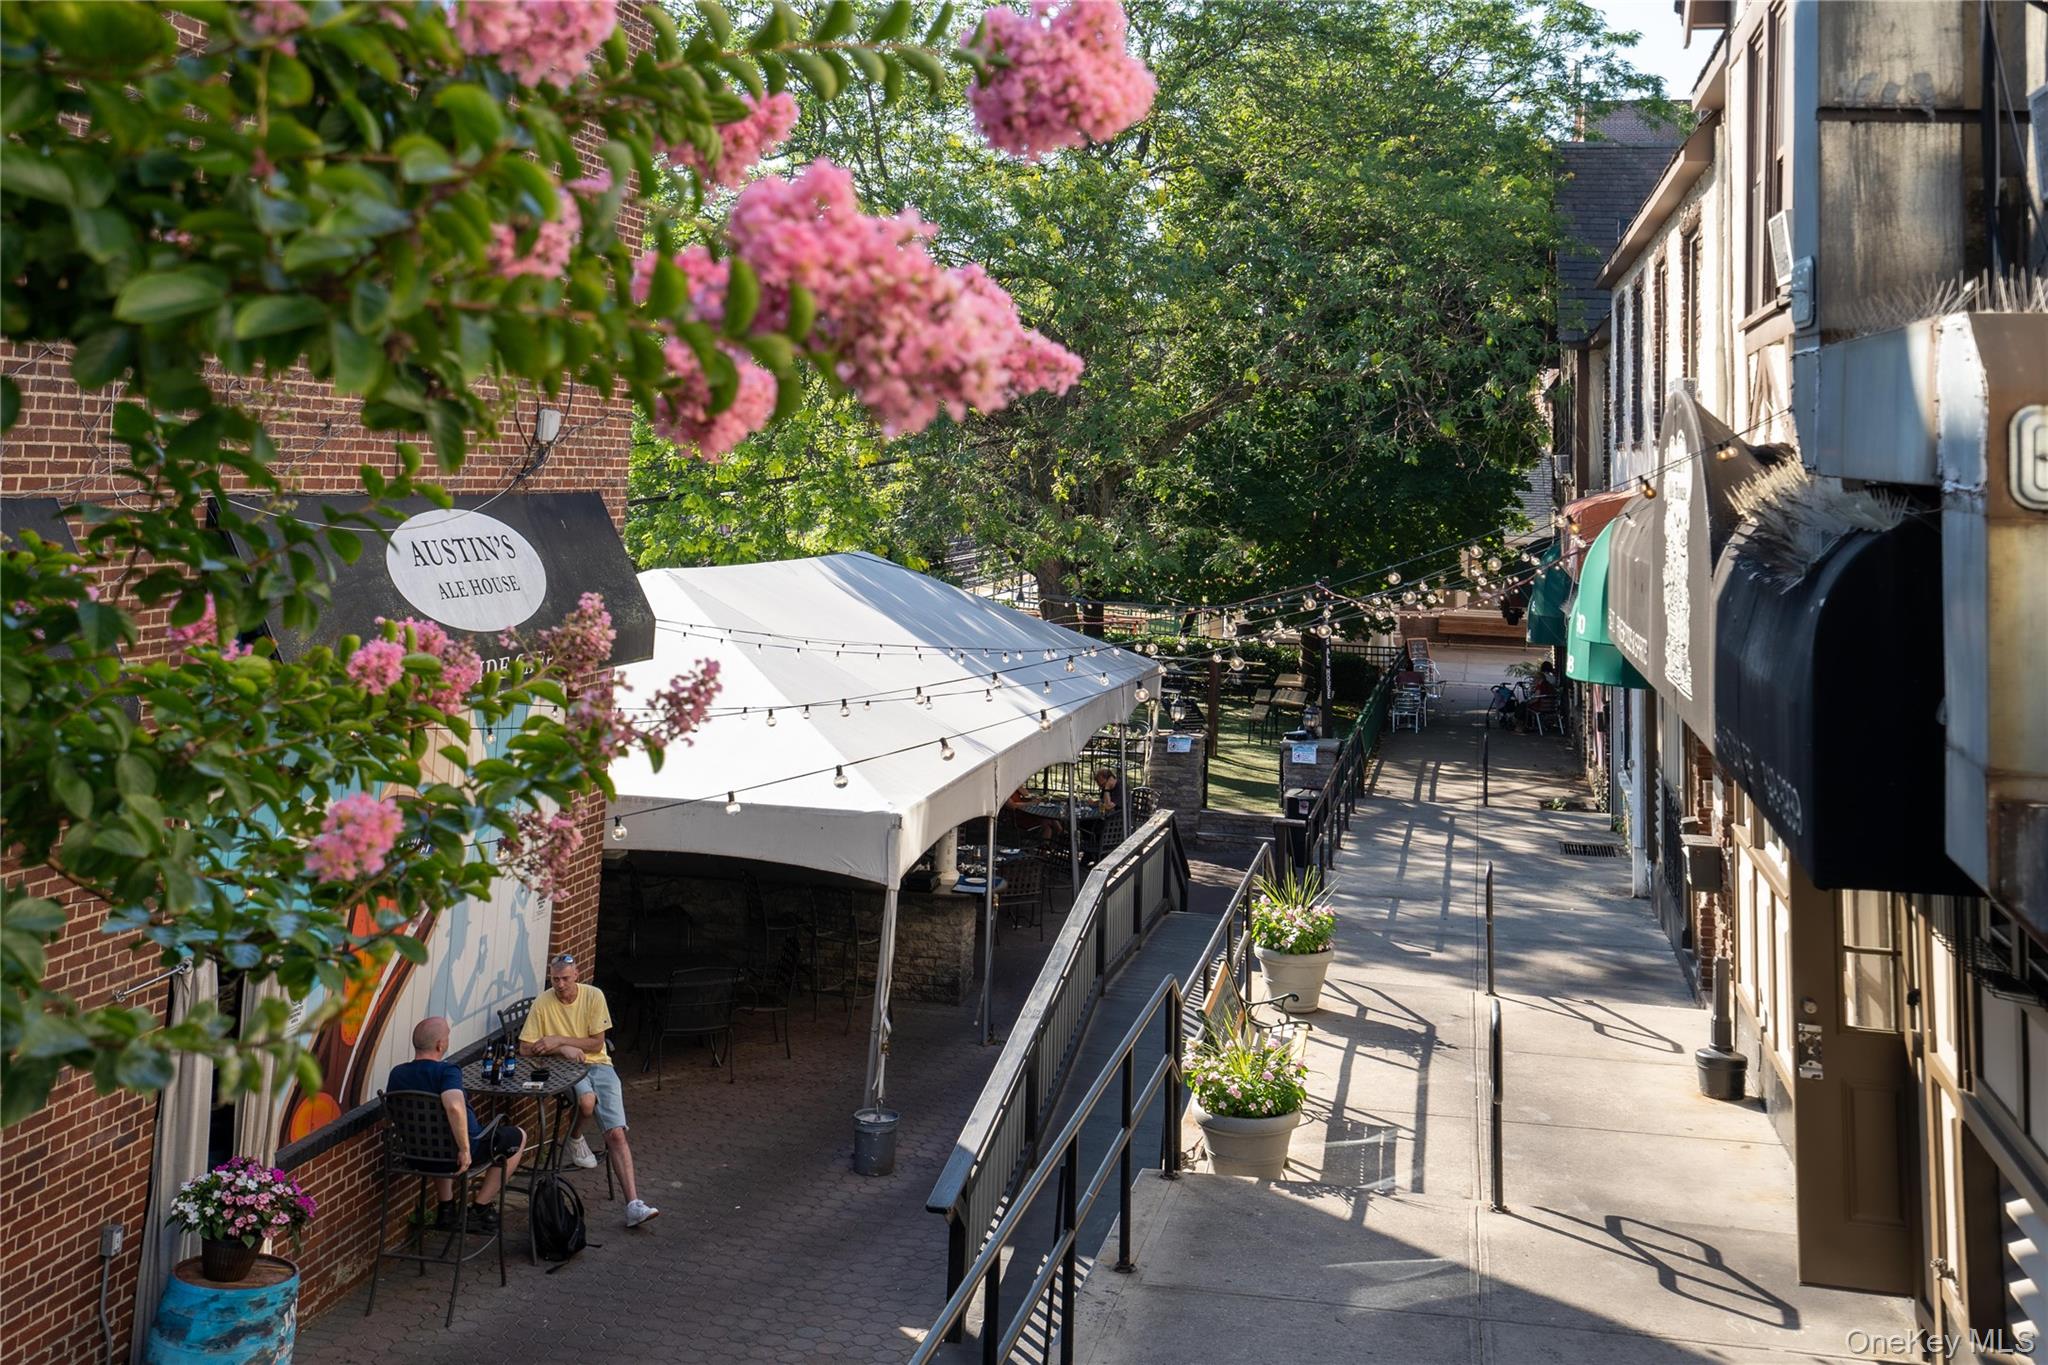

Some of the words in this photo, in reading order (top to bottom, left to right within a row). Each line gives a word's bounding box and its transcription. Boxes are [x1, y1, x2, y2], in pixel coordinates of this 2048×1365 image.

[411, 534, 517, 568] AUSTIN'S
[438, 580, 469, 600] ALE
[469, 575, 521, 597] HOUSE
